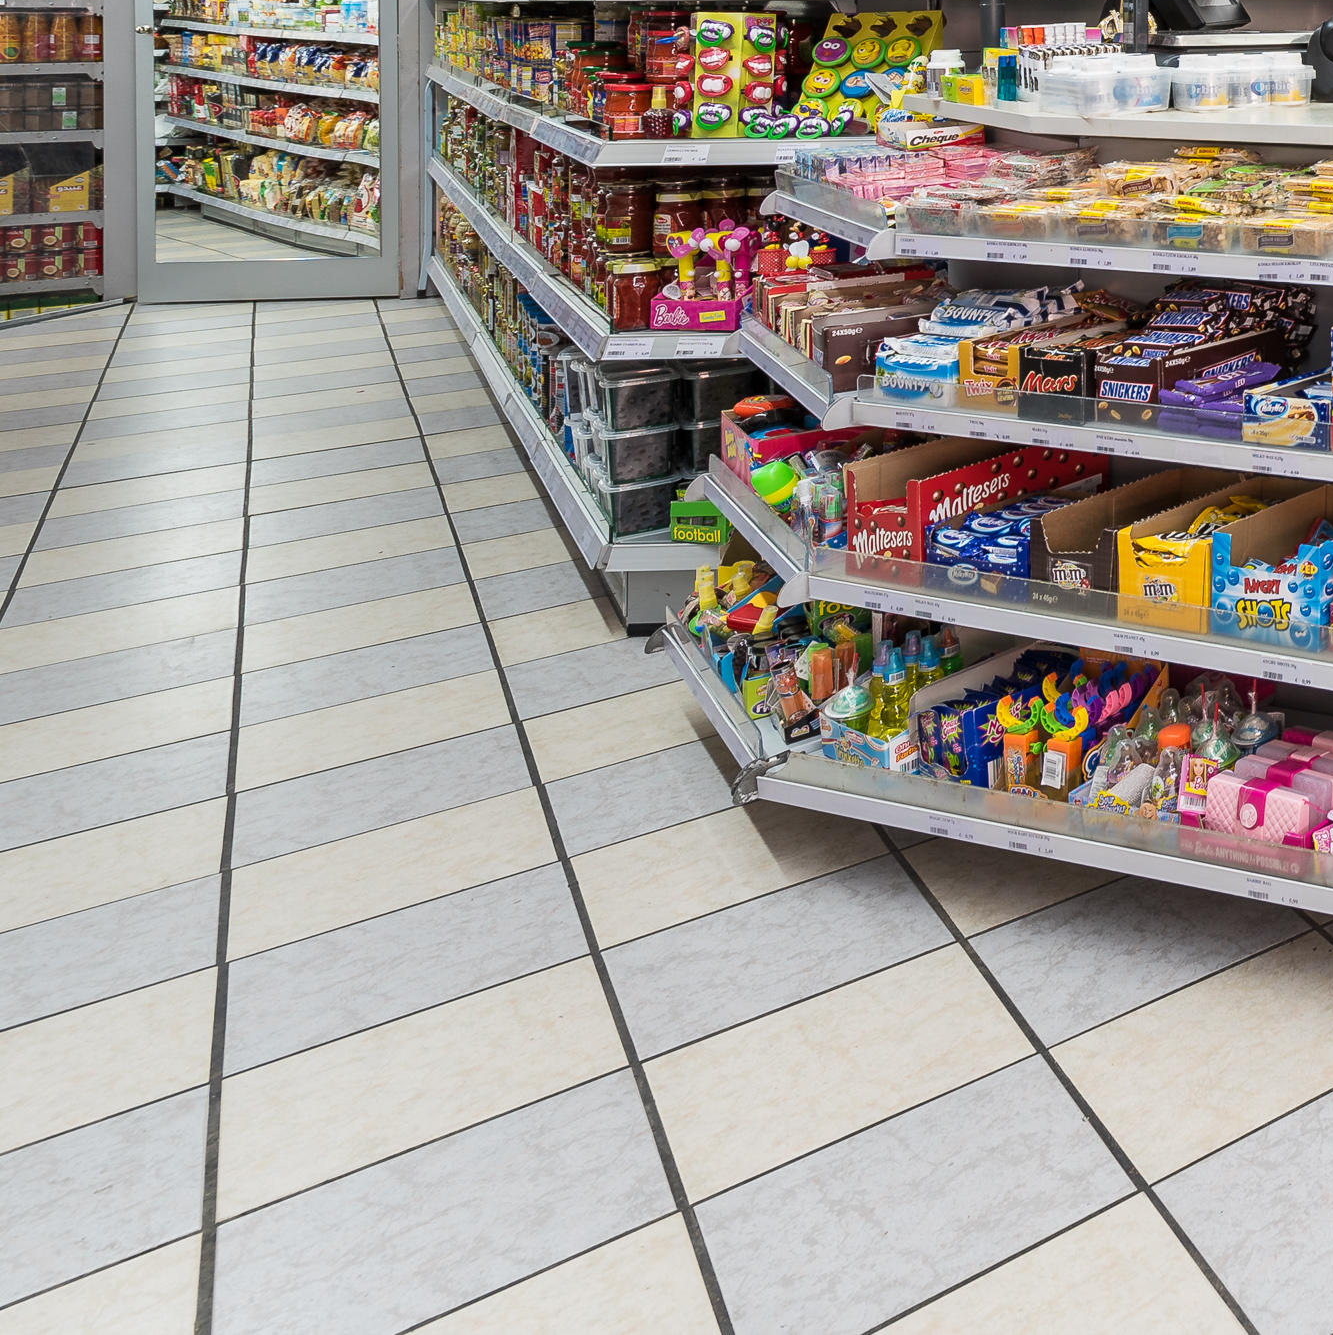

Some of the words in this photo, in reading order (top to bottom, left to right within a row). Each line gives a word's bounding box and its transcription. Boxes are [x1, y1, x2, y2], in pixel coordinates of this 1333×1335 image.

[653, 303, 690, 327] Barbie
[944, 304, 996, 324] BOUNTY
[881, 374, 931, 392] BOUNTY
[1022, 370, 1078, 394] Mars
[1102, 380, 1152, 403] SNICKERS
[1235, 378, 1246, 388] LEO
[929, 472, 1010, 523] Maltesers
[673, 526, 721, 544] football
[852, 528, 913, 561] Maltesers
[1243, 577, 1281, 595] ANGRY
[1236, 597, 1292, 631] SHOTS
